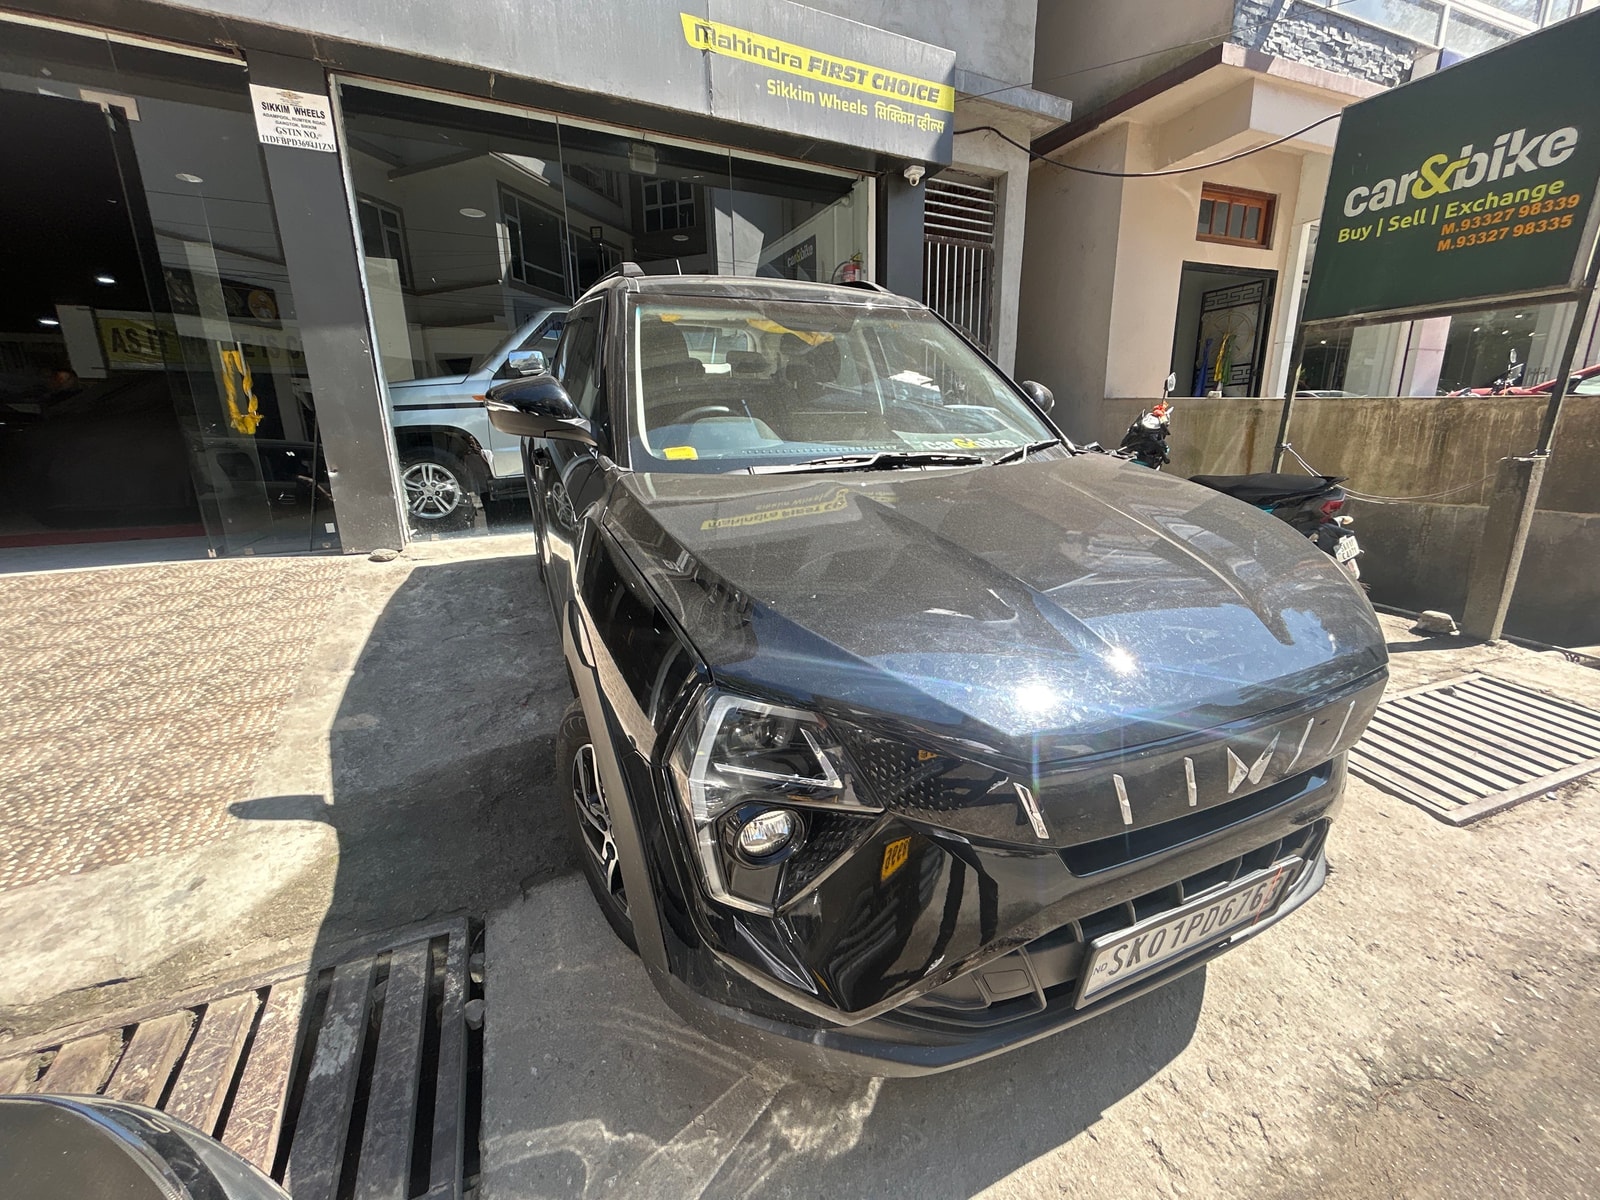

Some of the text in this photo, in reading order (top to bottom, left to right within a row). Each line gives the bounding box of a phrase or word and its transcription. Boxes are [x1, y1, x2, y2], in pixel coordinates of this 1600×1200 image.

[694, 23, 940, 103] Mahindra FIRST CHOICE
[261, 101, 290, 114] SIKKIM
[293, 107, 326, 119] WHEELS
[767, 79, 868, 116] Sikkim Wheels
[275, 126, 302, 137] GSTIN
[874, 101, 945, 133] सिक्किम व्हील्स
[1343, 126, 1579, 217] car&bike
[1337, 226, 1373, 243] Buy
[1388, 207, 1428, 231] Sell
[1444, 179, 1565, 219] Exchange
[1441, 194, 1580, 235] M.93327 98339
[1436, 214, 1574, 252] M.93327 98335
